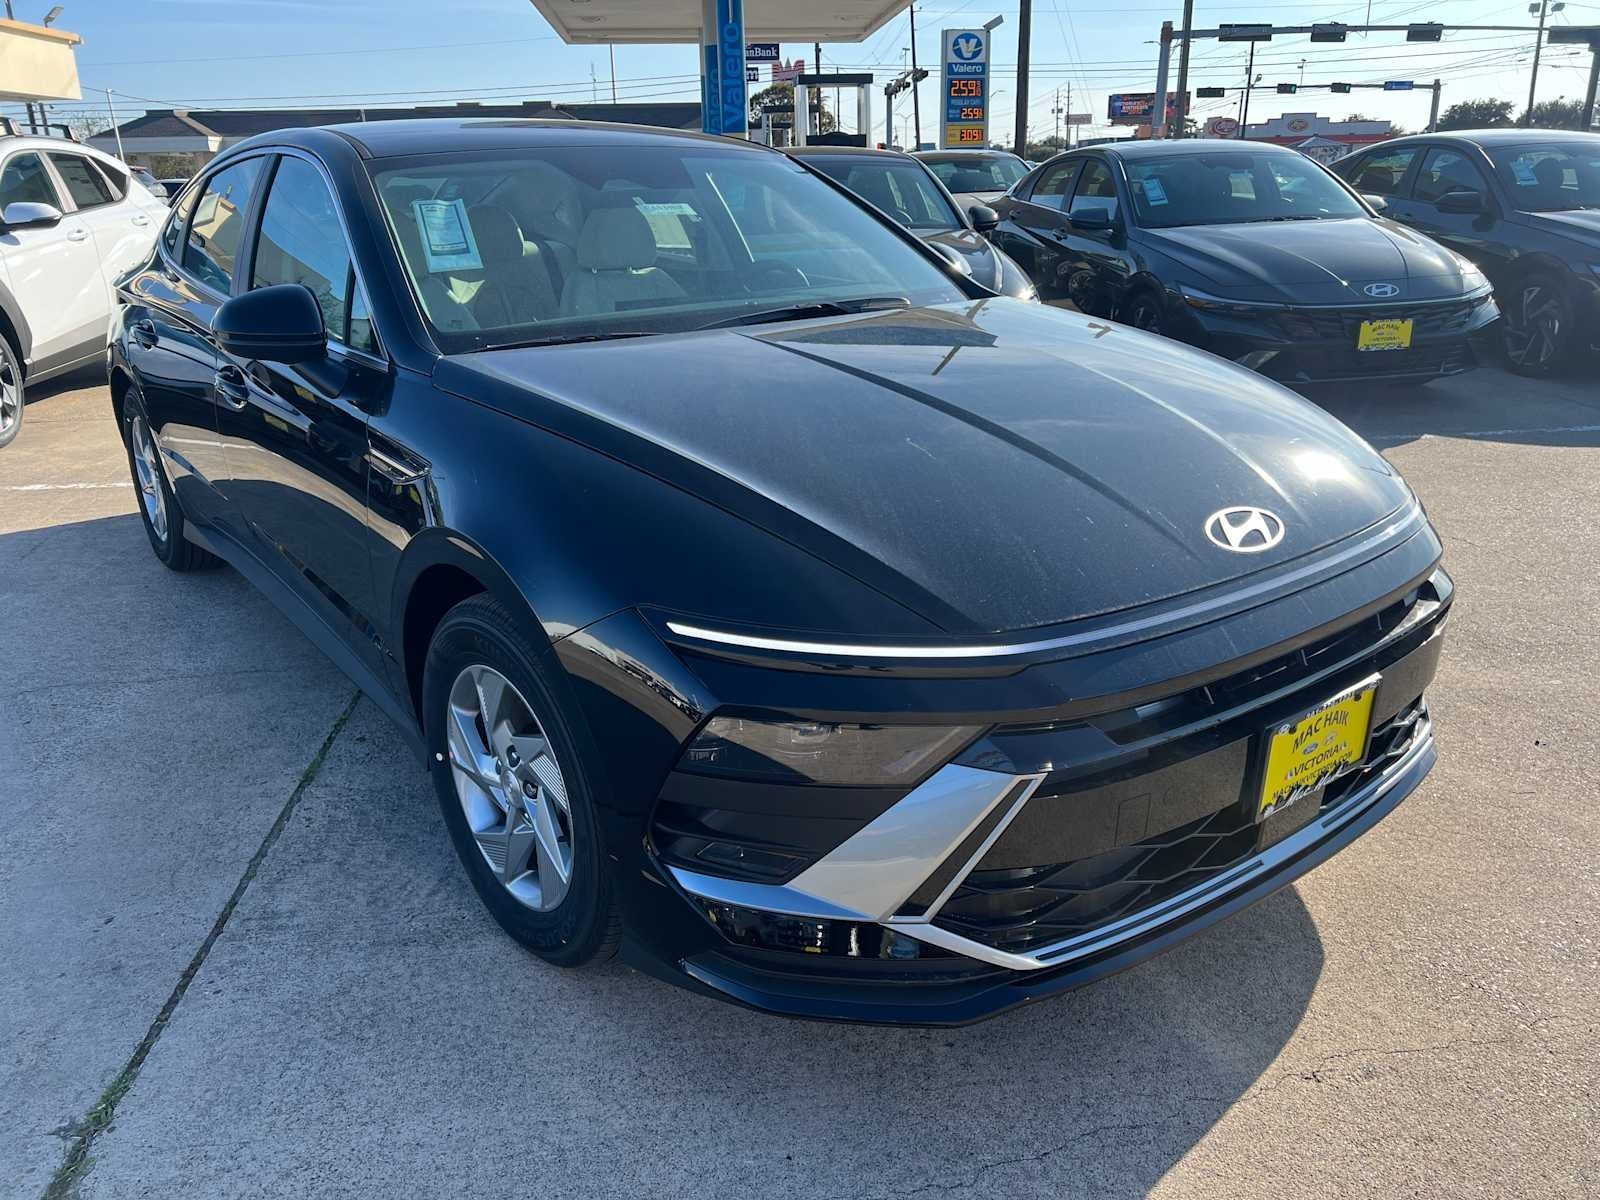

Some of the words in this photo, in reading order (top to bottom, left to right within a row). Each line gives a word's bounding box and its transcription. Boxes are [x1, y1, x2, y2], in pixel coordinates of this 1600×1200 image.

[723, 23, 743, 129] Valero
[952, 64, 982, 73] Valero
[1292, 717, 1322, 753] MAC
[1323, 710, 1349, 728] HAIK
[1293, 745, 1340, 777] VICTORIA
